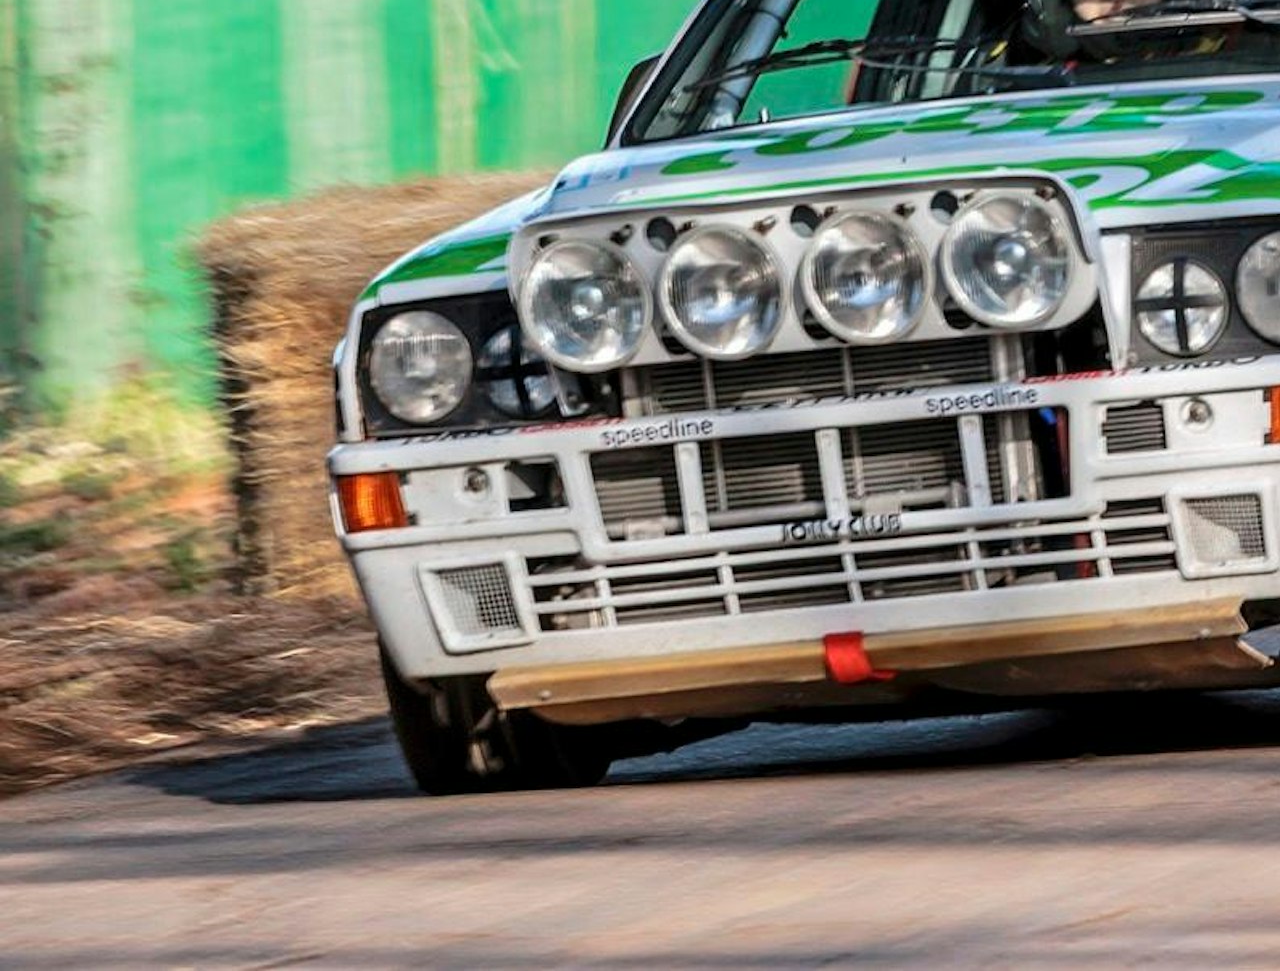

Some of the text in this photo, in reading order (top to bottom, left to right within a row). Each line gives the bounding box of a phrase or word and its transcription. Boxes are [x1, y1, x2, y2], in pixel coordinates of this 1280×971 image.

[926, 384, 1039, 414] speedline
[602, 414, 714, 448] speedline
[849, 513, 902, 535] CLUB
